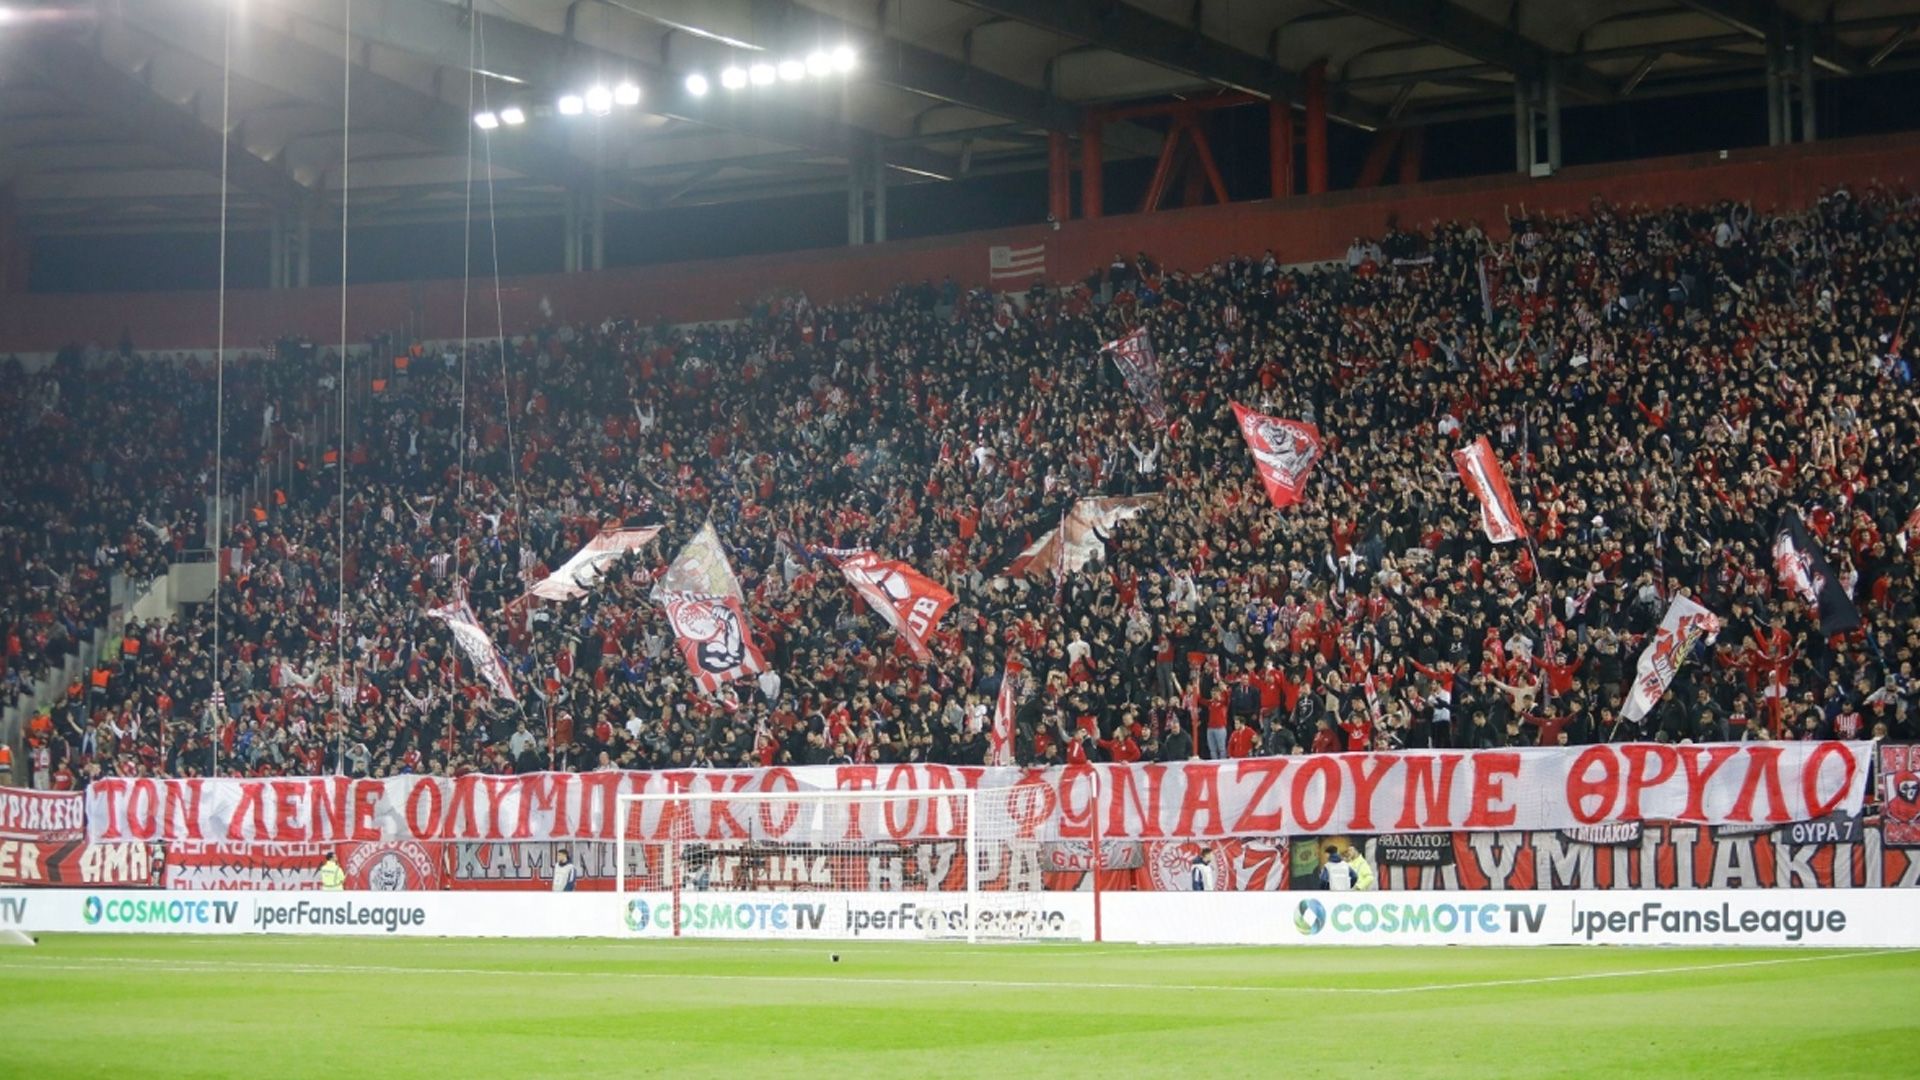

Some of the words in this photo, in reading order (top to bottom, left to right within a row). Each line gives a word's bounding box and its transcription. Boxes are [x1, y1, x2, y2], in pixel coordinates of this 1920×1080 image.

[93, 778, 204, 840] ΤΟΝ
[226, 776, 386, 842] ΛΕΝΕ
[836, 762, 985, 840] ΤΟΝ
[1565, 740, 1857, 825] ΘΡΥΛΟ
[1791, 822, 1839, 843] ΘΥΡΑ
[1843, 821, 1853, 841] 7
[1051, 850, 1109, 870] GATE
[1121, 847, 1133, 863] 7
[105, 899, 210, 923] COSMOTE
[212, 901, 239, 924] TV
[792, 903, 827, 930] TV
[1330, 903, 1501, 933] COSMOTE
[1504, 904, 1547, 933] TV
